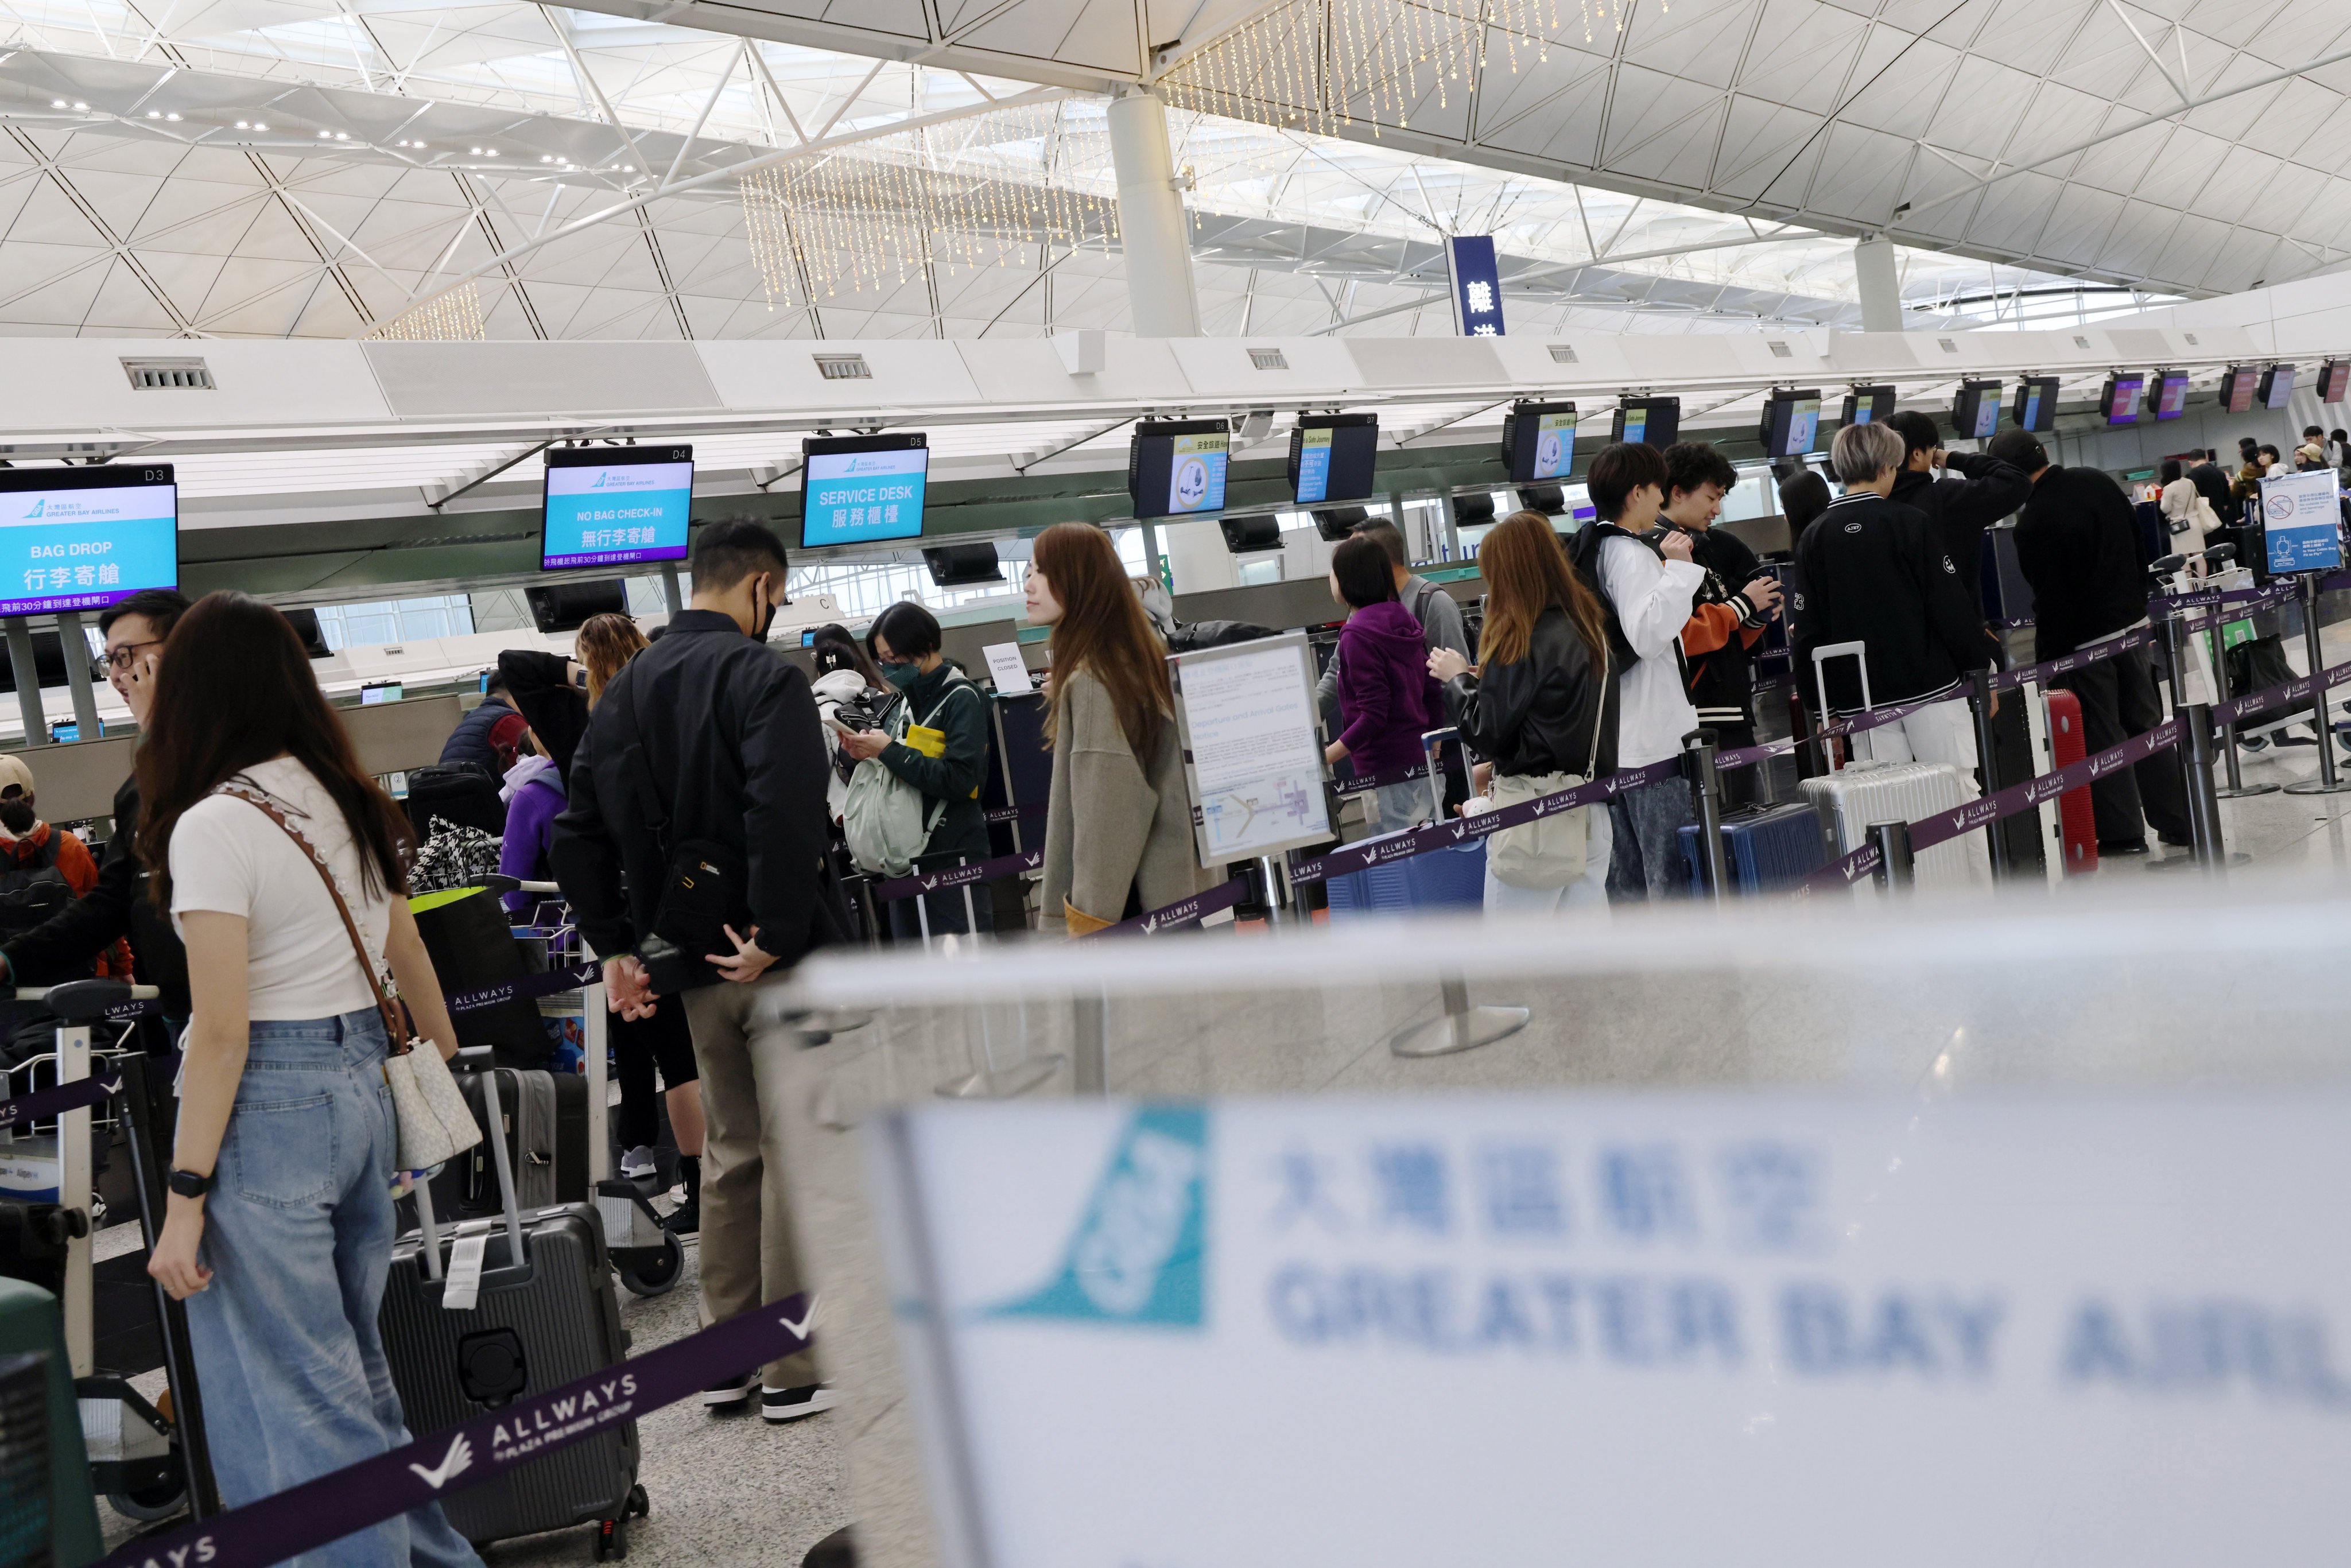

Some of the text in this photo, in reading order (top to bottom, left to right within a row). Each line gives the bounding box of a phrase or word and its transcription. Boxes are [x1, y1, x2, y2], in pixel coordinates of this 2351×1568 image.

[911, 437, 921, 447] D5
[1317, 435, 1330, 444] Journey
[673, 450, 685, 460] D4
[145, 469, 165, 482] D3
[819, 486, 913, 506] SERVICE DESK
[46, 503, 82, 511] 大灣區航空
[577, 507, 662, 521] NO BAG CHECK-IN
[832, 504, 899, 529] 服務櫃檯
[581, 526, 656, 548] 無行李寄艙
[31, 542, 112, 558] BAG DROP
[24, 562, 120, 591] 行李寄艙
[1794, 592, 1805, 611] 23
[2186, 595, 2221, 603] ALLWAYS
[2094, 647, 2108, 656] ALLWAYS
[2059, 658, 2074, 666] ALLWAYS
[2022, 668, 2038, 677] ALLWAYS
[2292, 681, 2310, 693] ALLWAYS
[2244, 696, 2264, 709] ALLWAYS
[1191, 703, 1298, 729] Departure and Arrival Gates
[1875, 711, 1897, 722] ALLWAYS
[1194, 731, 1219, 740] Notice
[2156, 725, 2177, 741] ALLWAYS
[1714, 753, 1741, 764] ALLWAYS
[2101, 749, 2124, 766] ALLWAYS
[1418, 761, 1444, 772] ALLYS
[1348, 776, 1376, 787] ALLWAYS
[1619, 770, 1646, 785] ALLWAYS
[2038, 774, 2063, 792] ALLWAYS
[1547, 793, 1577, 807] ALLWAYS
[990, 809, 1019, 817] ALLWAYS
[1968, 800, 1997, 819] ALLWAYS
[1468, 814, 1500, 830] ALLWAYS
[1380, 838, 1416, 854] ALLWAYS
[1857, 846, 1880, 865] ALLWA
[942, 867, 983, 882] ALLWAYS
[1161, 901, 1198, 922] ALLWAYS
[455, 985, 513, 1005] ALLWAYS
[105, 1002, 144, 1015] LWAYS
[1268, 1264, 1743, 1371] GREATER
[1778, 1277, 2007, 1377] BAY
[492, 1373, 637, 1447] ALLWAYS
